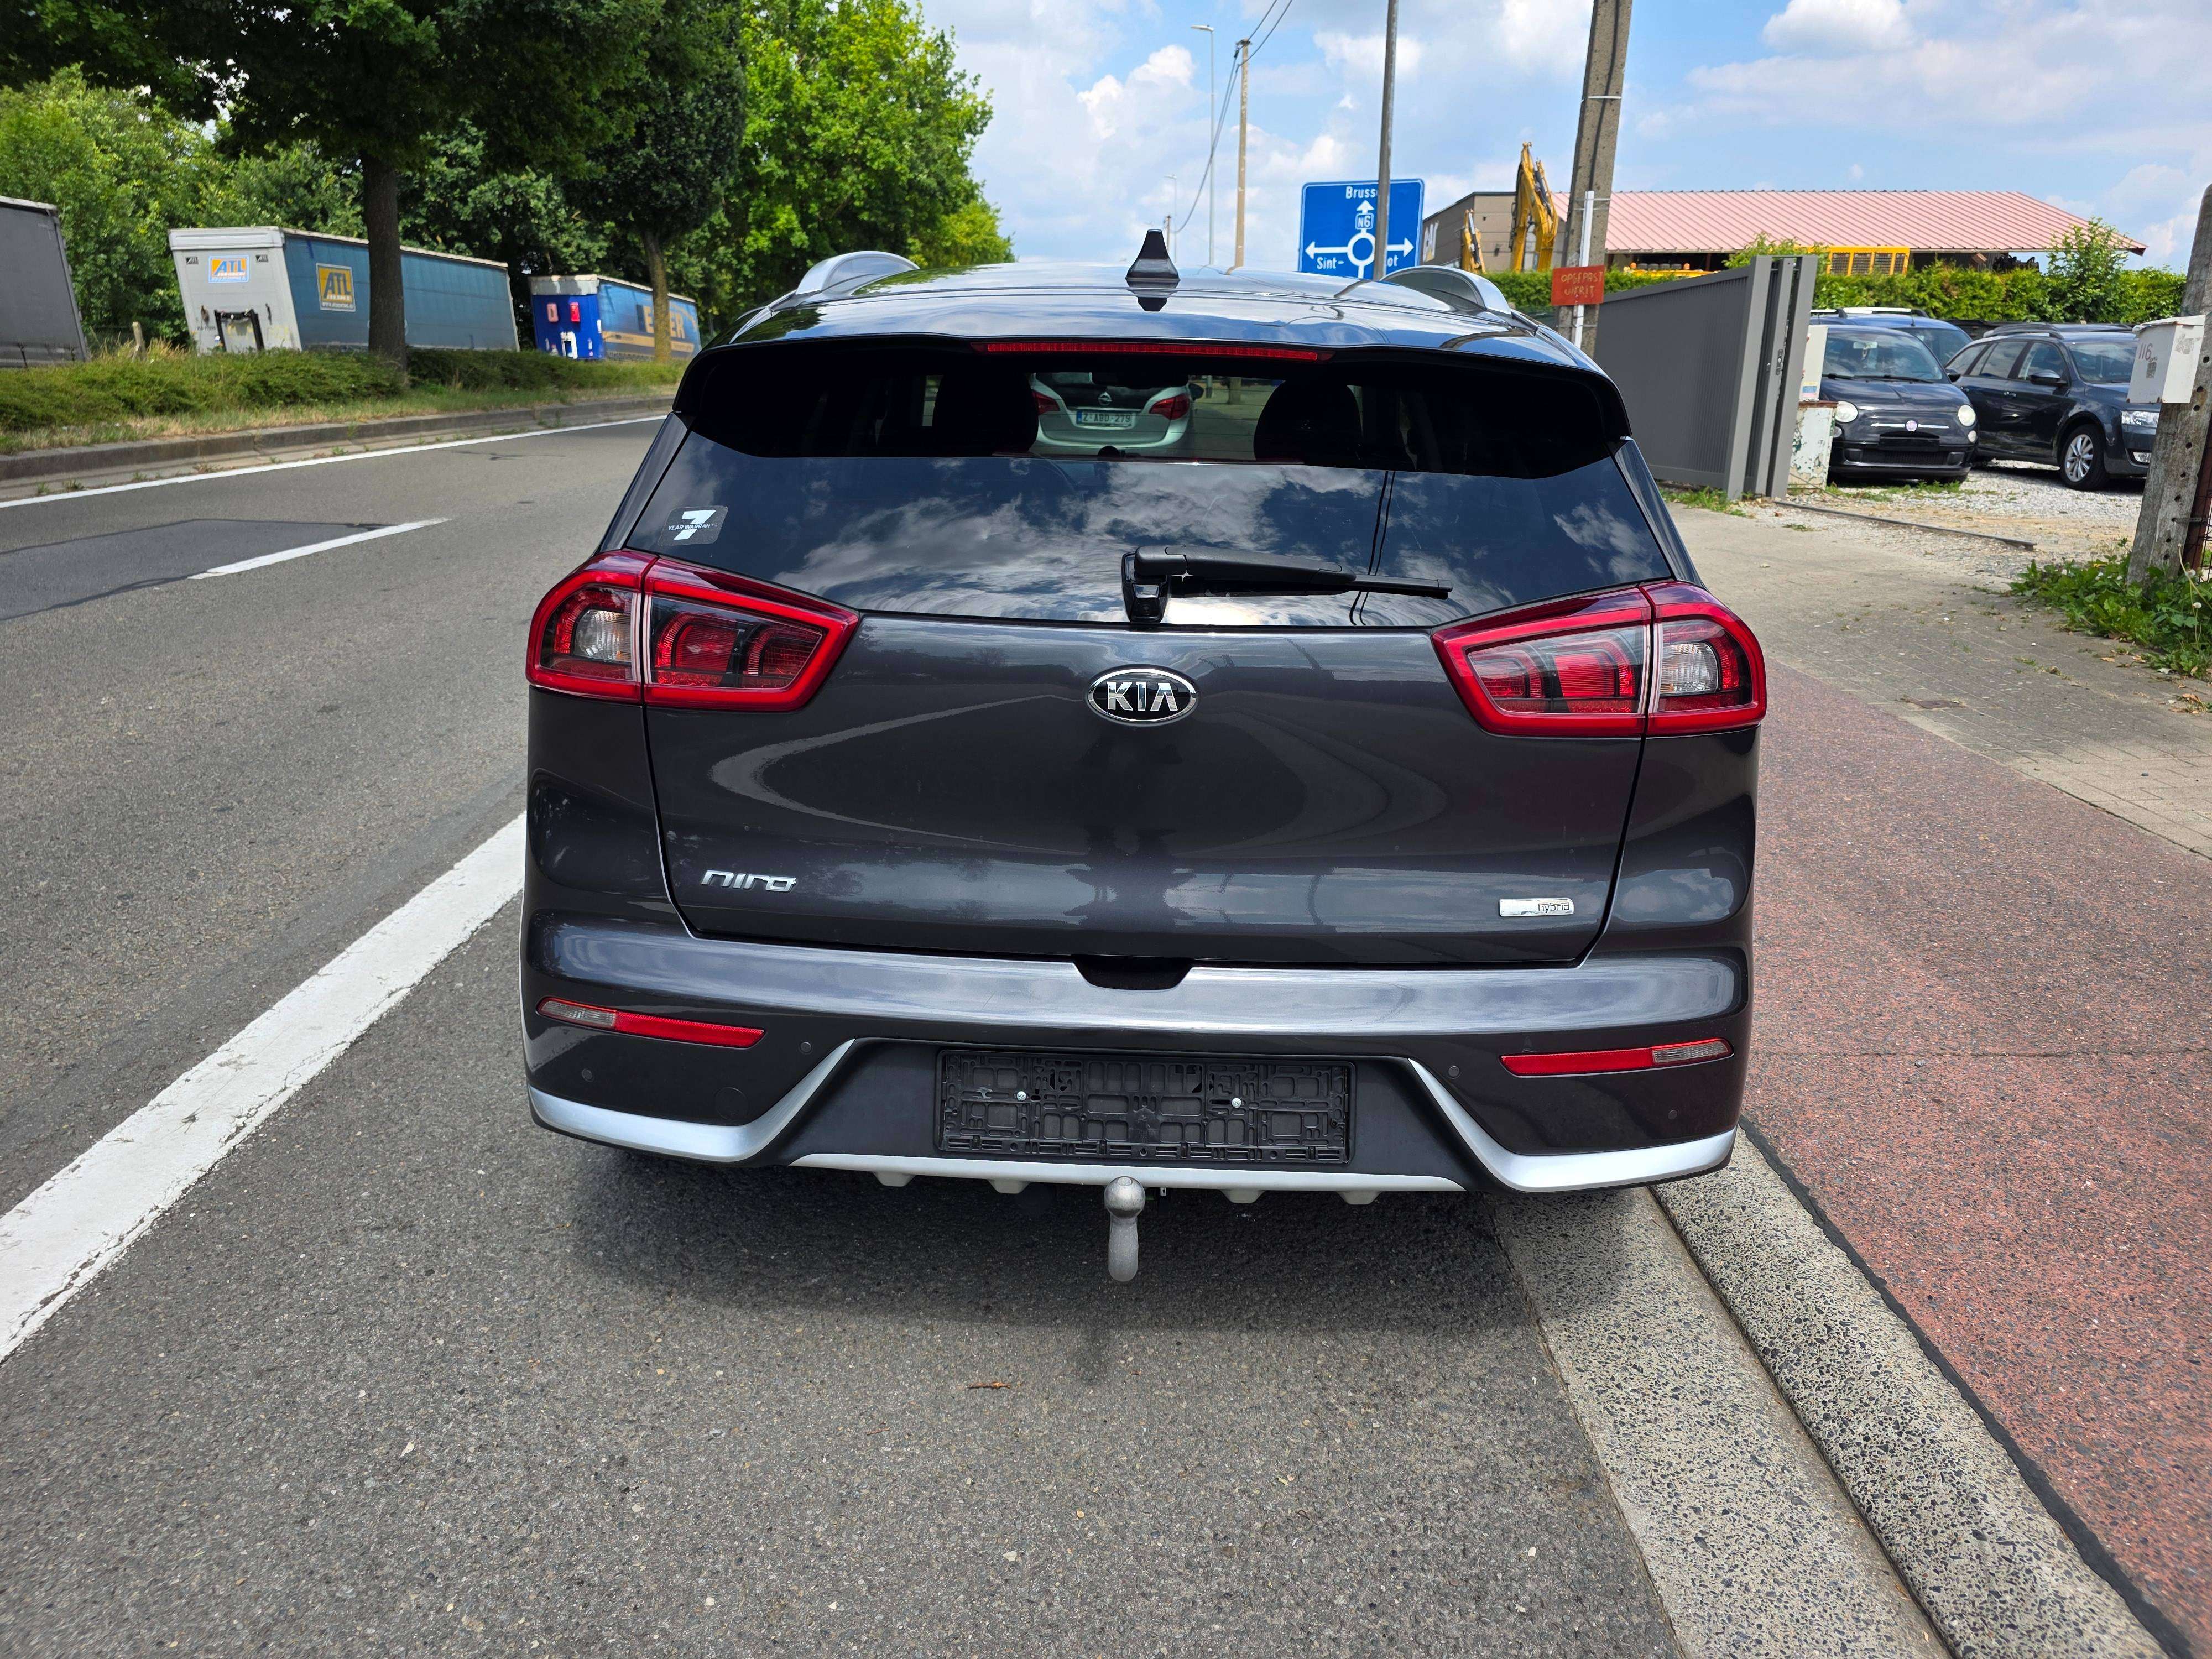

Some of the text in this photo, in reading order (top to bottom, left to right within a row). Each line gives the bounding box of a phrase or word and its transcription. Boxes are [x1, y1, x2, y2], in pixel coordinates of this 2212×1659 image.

[1345, 186, 1379, 199] Bruss
[1357, 215, 1371, 227] N6
[214, 260, 245, 275] ATL
[1317, 257, 1344, 270] Sint-
[1386, 255, 1399, 267] ot
[323, 272, 351, 299] ATL
[2138, 342, 2153, 359] 116
[674, 510, 716, 540] 7
[1107, 681, 1178, 711] KIA
[700, 870, 797, 892] niro
[1538, 902, 1569, 913] hybrid
